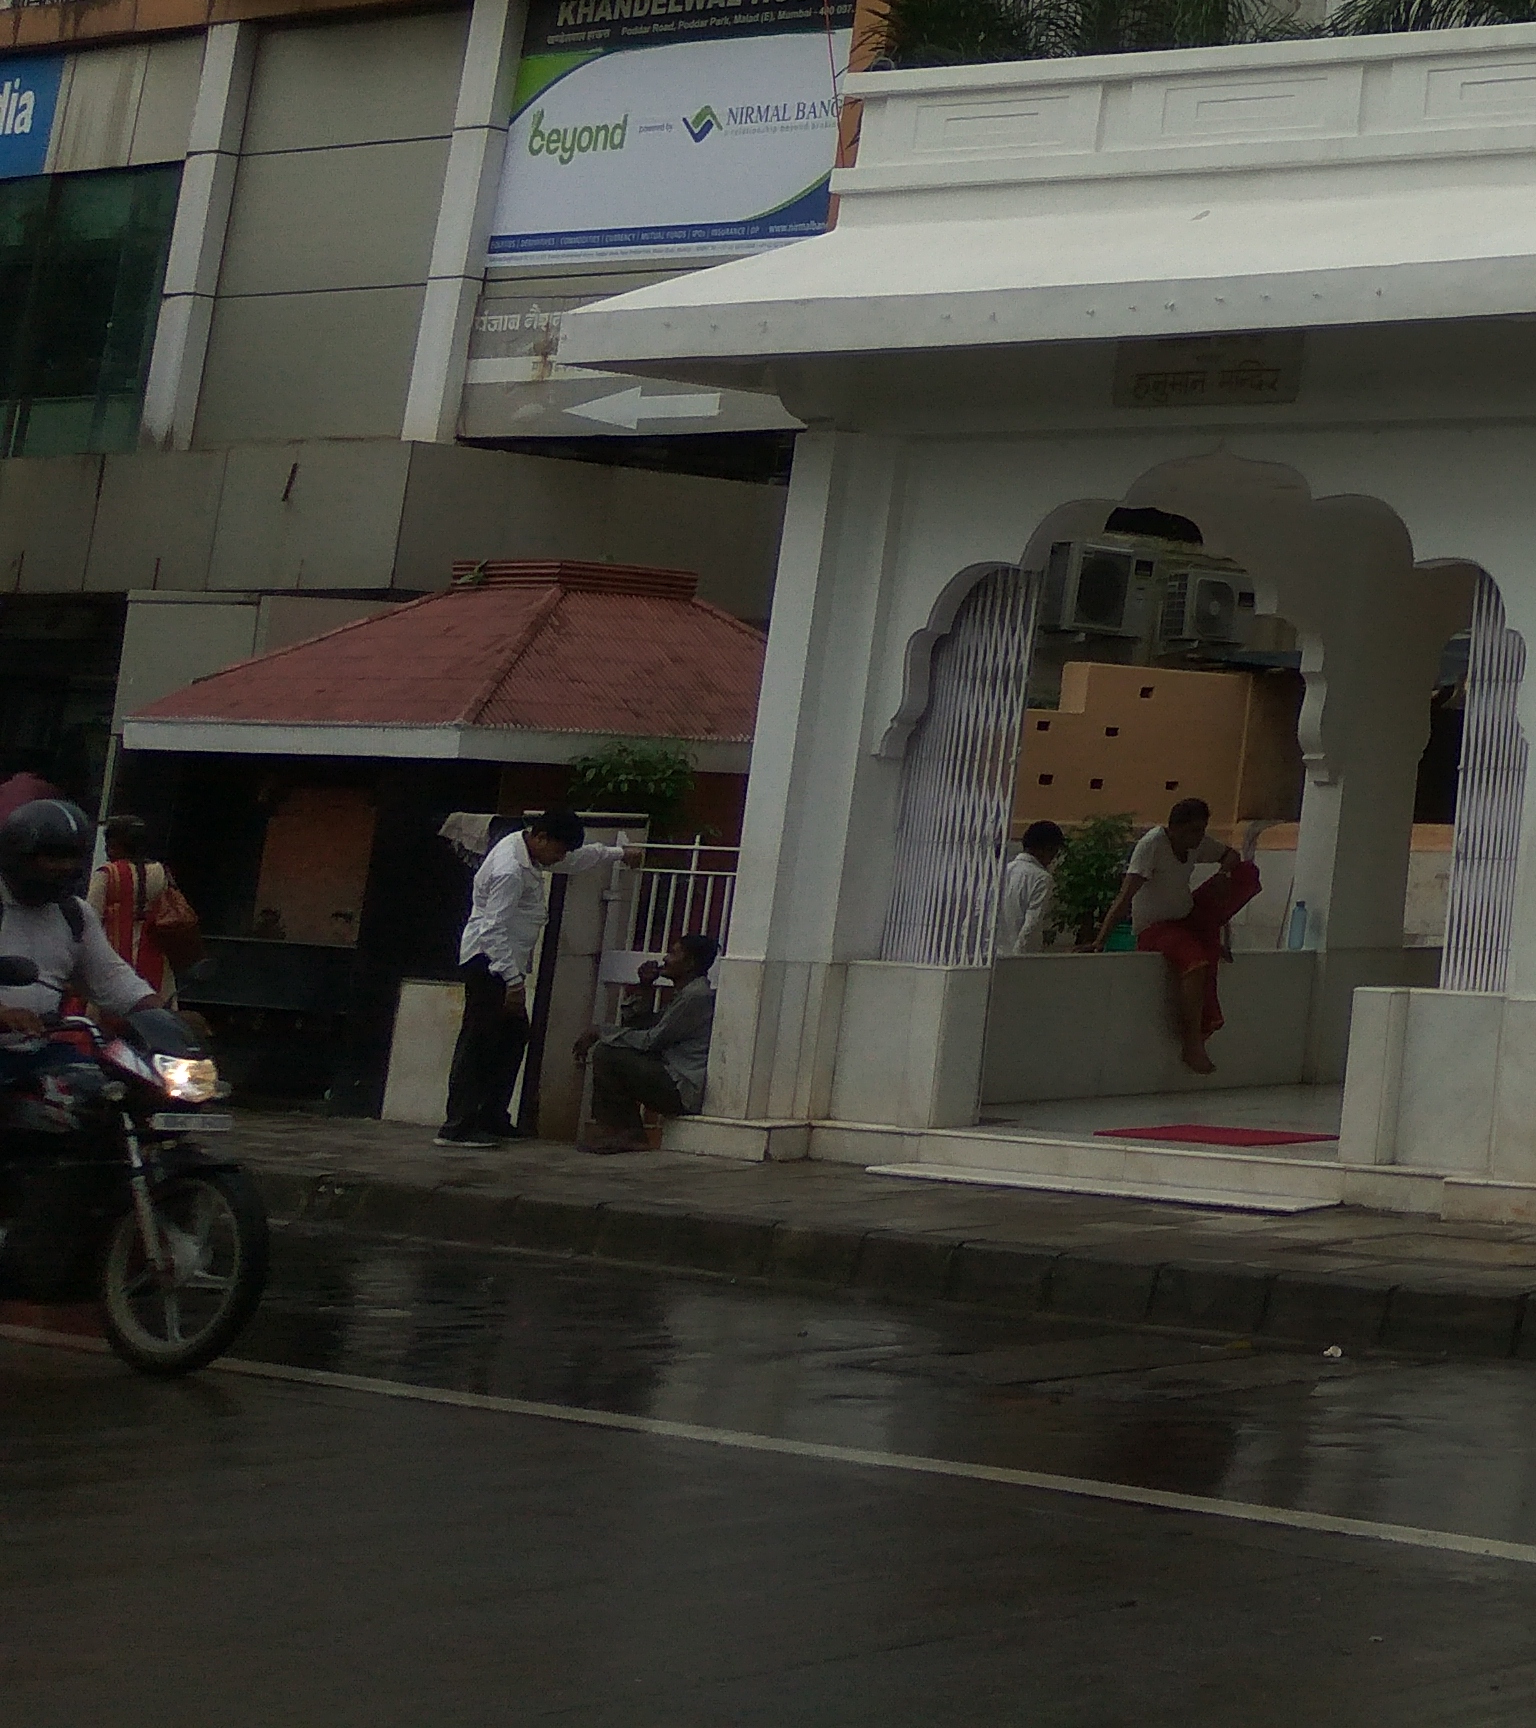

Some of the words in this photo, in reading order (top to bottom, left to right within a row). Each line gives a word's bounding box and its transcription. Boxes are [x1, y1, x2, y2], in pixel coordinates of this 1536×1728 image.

[678, 18, 707, 30] Poddar
[709, 15, 731, 28] Park,
[733, 12, 759, 25] Malad
[777, 7, 812, 20] Mumbai
[726, 103, 791, 126] NIRMAL
[528, 108, 629, 166] beyond
